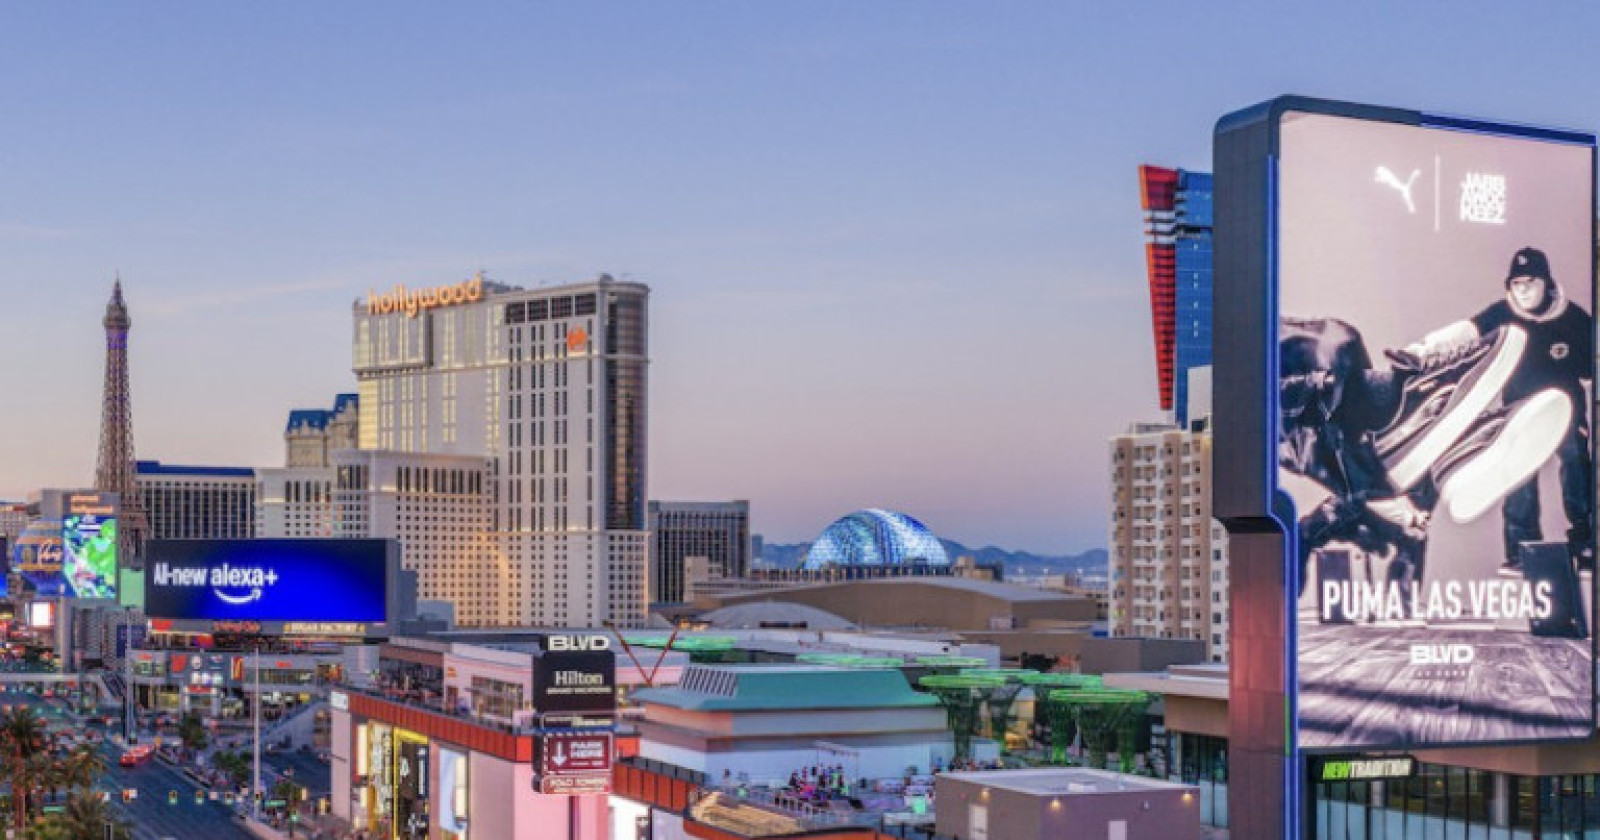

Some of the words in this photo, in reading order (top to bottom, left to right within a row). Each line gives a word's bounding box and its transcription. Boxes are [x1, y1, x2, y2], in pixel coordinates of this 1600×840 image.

[367, 271, 482, 318] hollywood
[210, 562, 279, 587] alexa+
[1322, 579, 1403, 620] PUMA
[1410, 579, 1462, 619] LAS
[1467, 579, 1553, 619] VEGAS
[548, 635, 610, 651] BLVD
[1409, 644, 1475, 664] BLVD
[554, 670, 605, 686] Hilton
